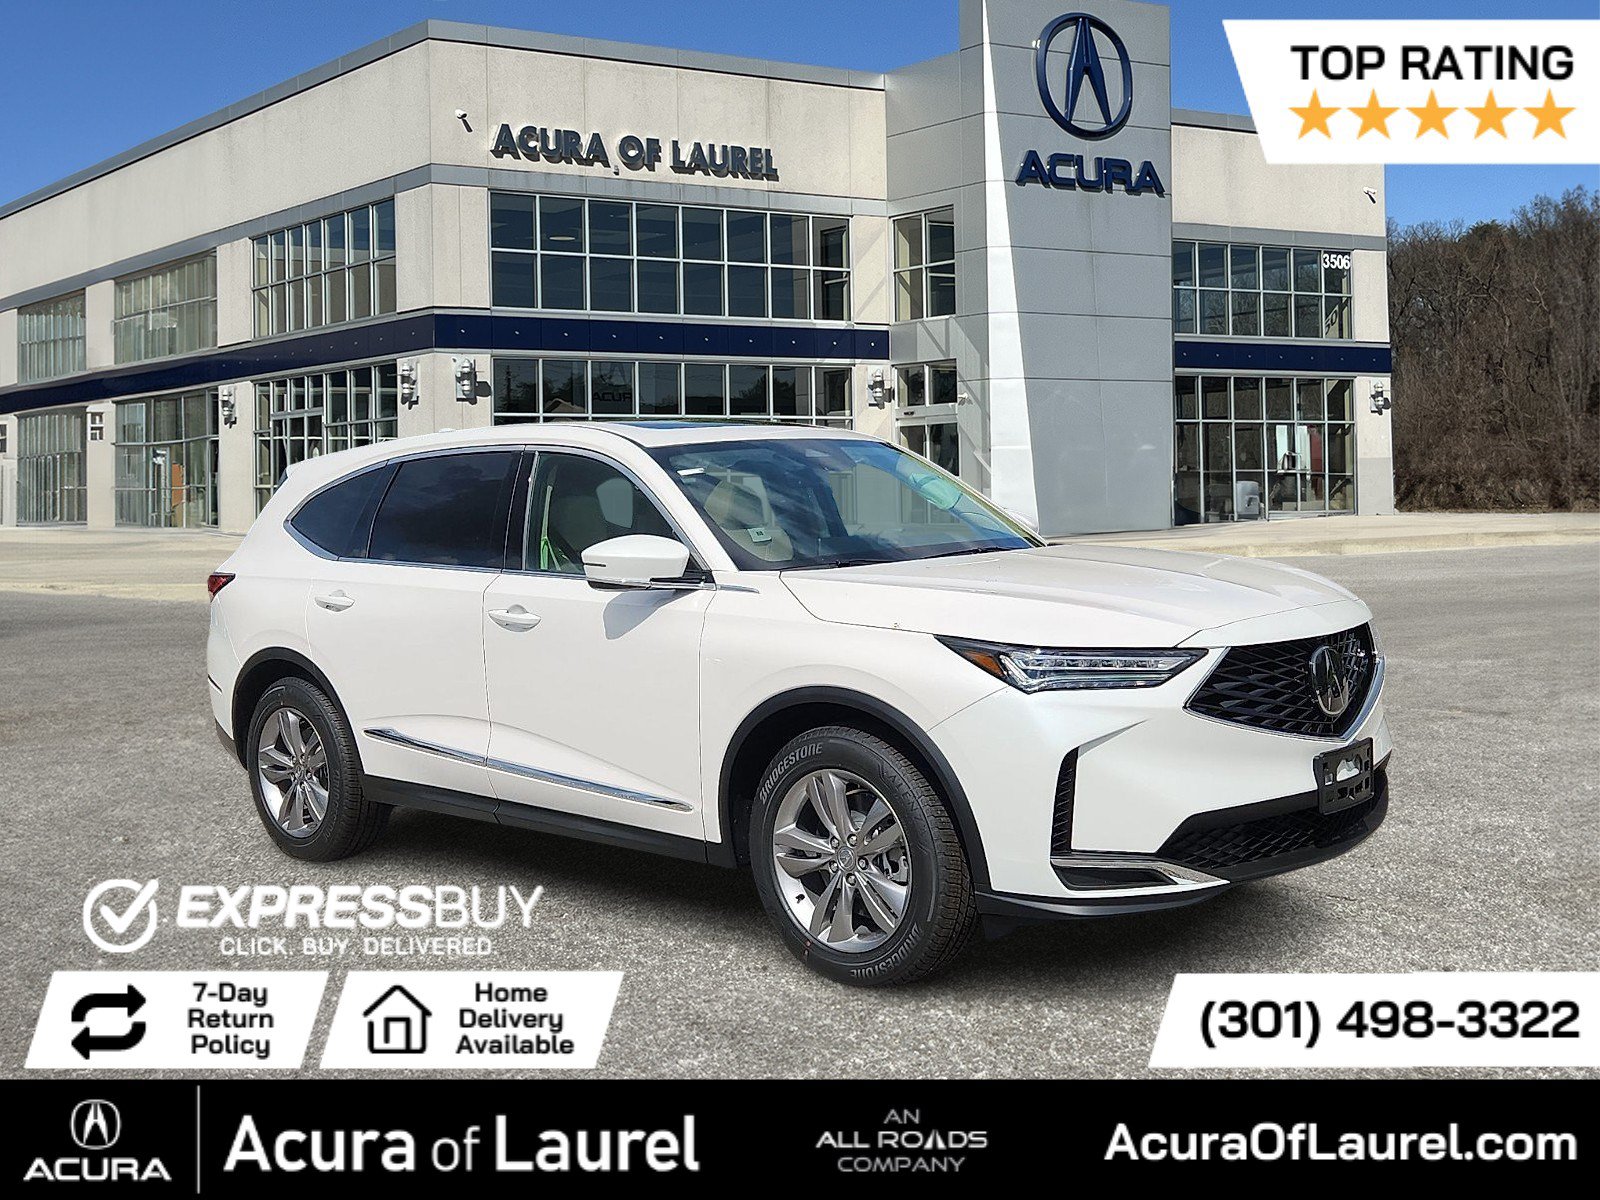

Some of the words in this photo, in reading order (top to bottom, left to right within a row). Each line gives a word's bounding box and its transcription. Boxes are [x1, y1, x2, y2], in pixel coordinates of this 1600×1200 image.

[490, 123, 610, 168] ACURA
[617, 134, 661, 171] OF
[671, 139, 779, 181] LAUREL
[1015, 150, 1165, 198] ACURA
[1322, 253, 1351, 270] 3506
[759, 742, 823, 805] BRIDGESTONE
[850, 922, 921, 979] BRIDGESTONE
